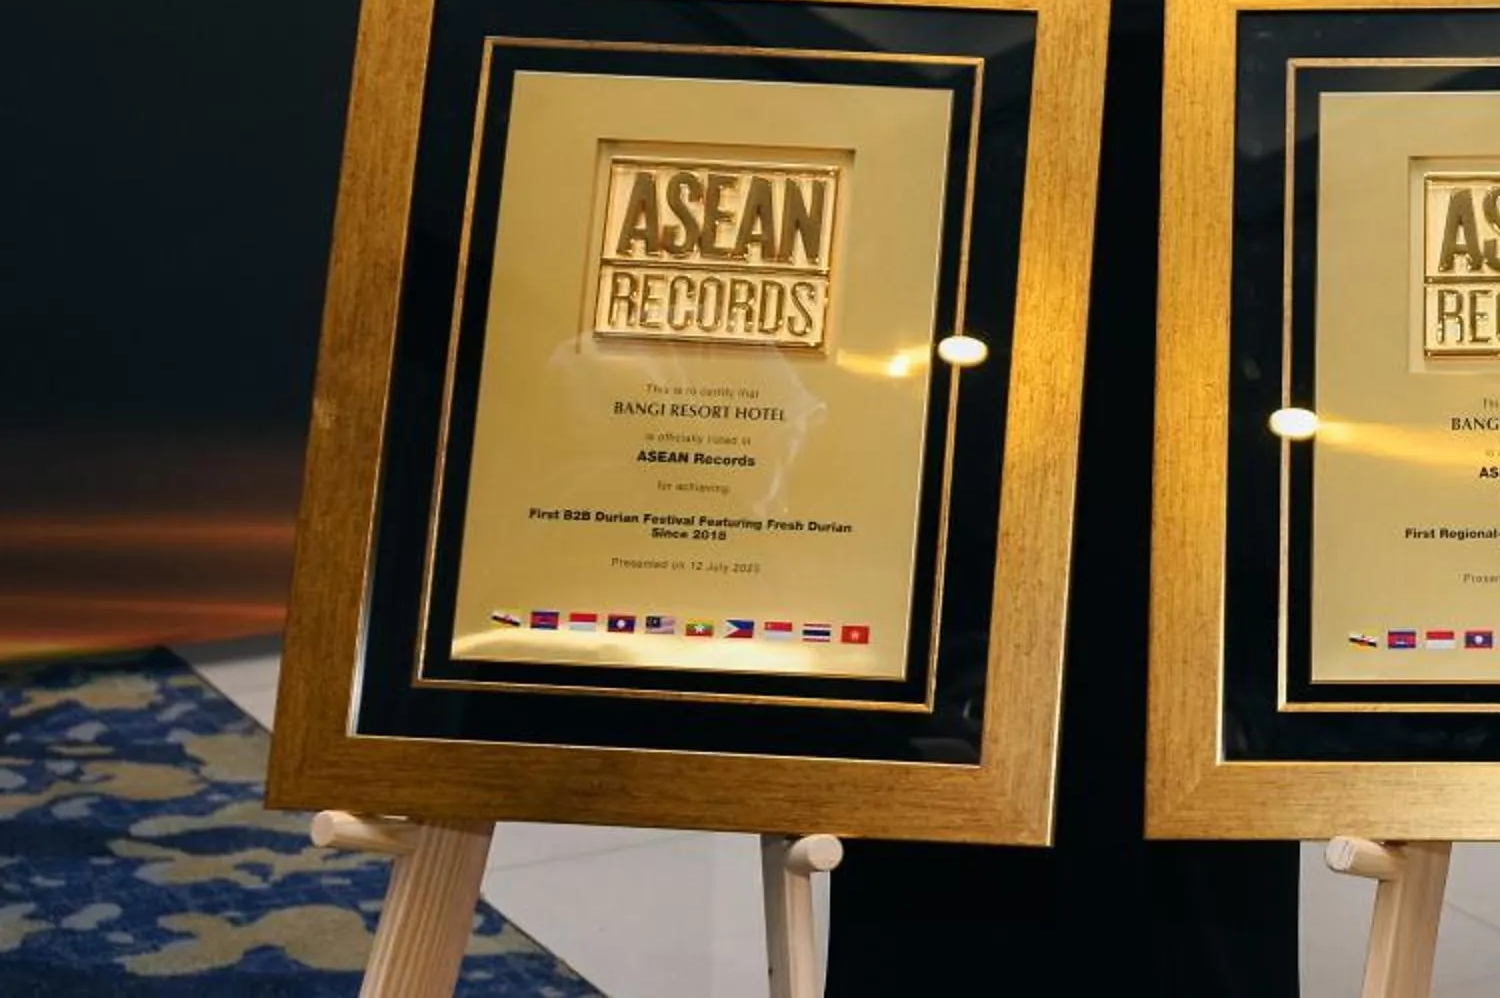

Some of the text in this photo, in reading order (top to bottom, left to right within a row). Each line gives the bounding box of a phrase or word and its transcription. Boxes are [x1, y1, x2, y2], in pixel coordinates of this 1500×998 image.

[616, 171, 828, 264] ASEAN
[608, 272, 816, 336] RECORDS
[614, 401, 786, 421] BANGI RESORT HOTEL
[636, 450, 756, 467] ASEAN Records
[529, 507, 853, 533] First B2B Durian Festival Featuring Fresh Durian
[651, 528, 727, 541] Since 2018
[1405, 528, 1435, 539] First
[611, 557, 668, 569] Presented
[690, 561, 703, 571] 12
[706, 562, 729, 574] July
